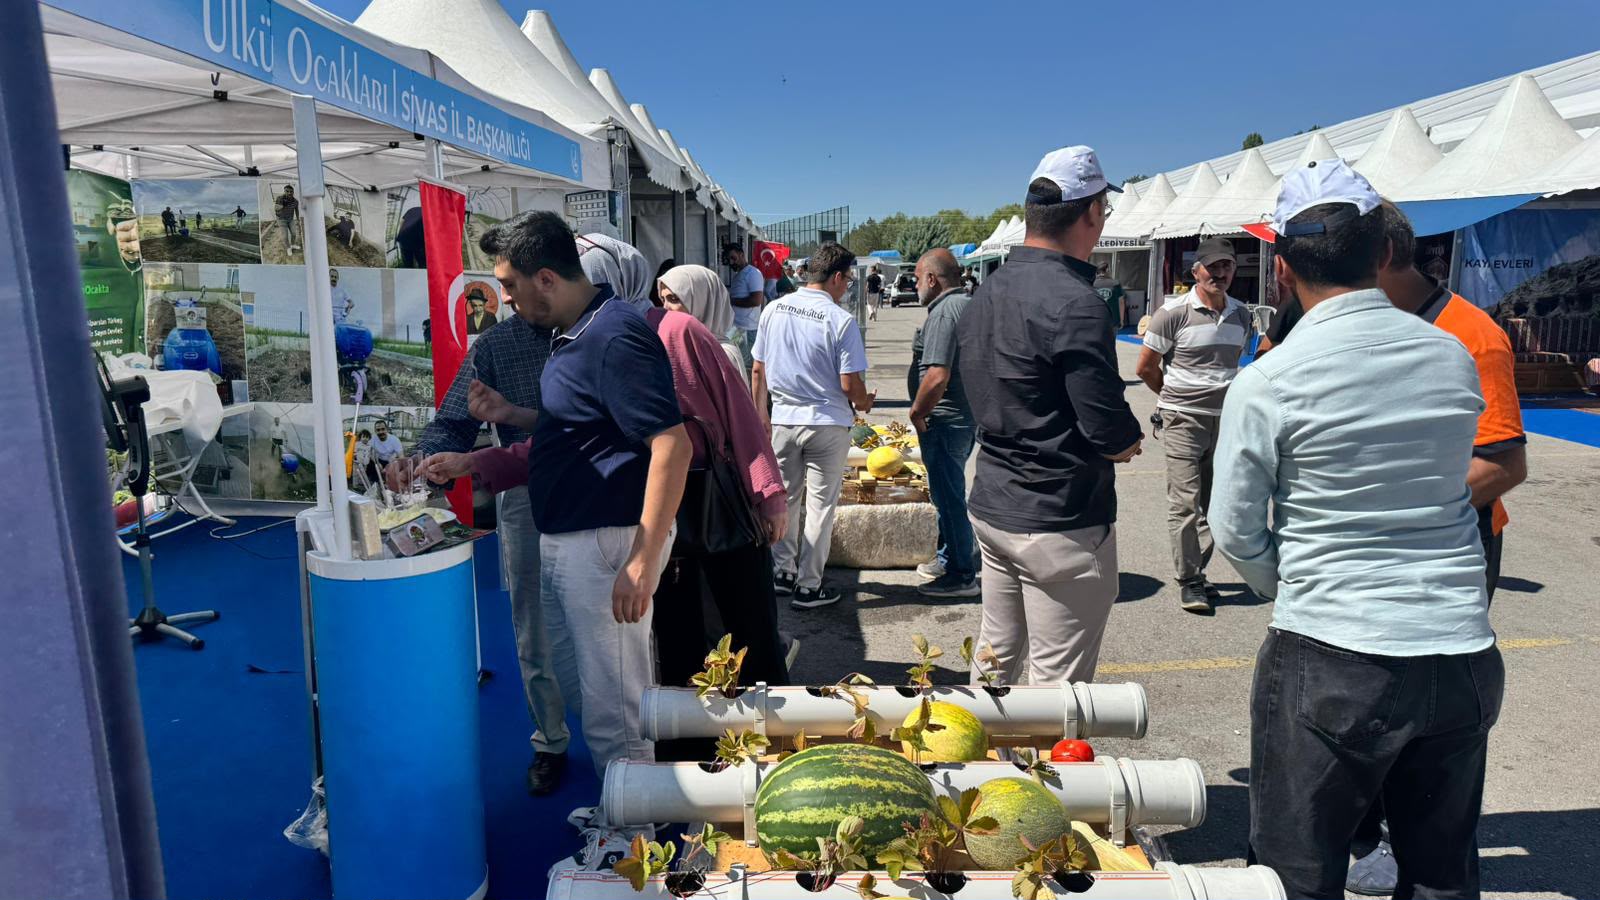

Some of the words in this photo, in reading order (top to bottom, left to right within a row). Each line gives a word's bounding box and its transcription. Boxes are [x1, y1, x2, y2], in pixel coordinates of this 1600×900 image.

[401, 85, 448, 133] SİVAS
[451, 100, 464, 139] İL
[467, 115, 531, 160] BAŞKANLIĞI
[1096, 238, 1137, 247] ELEDİYESİ
[1494, 257, 1534, 269] EVLERİ
